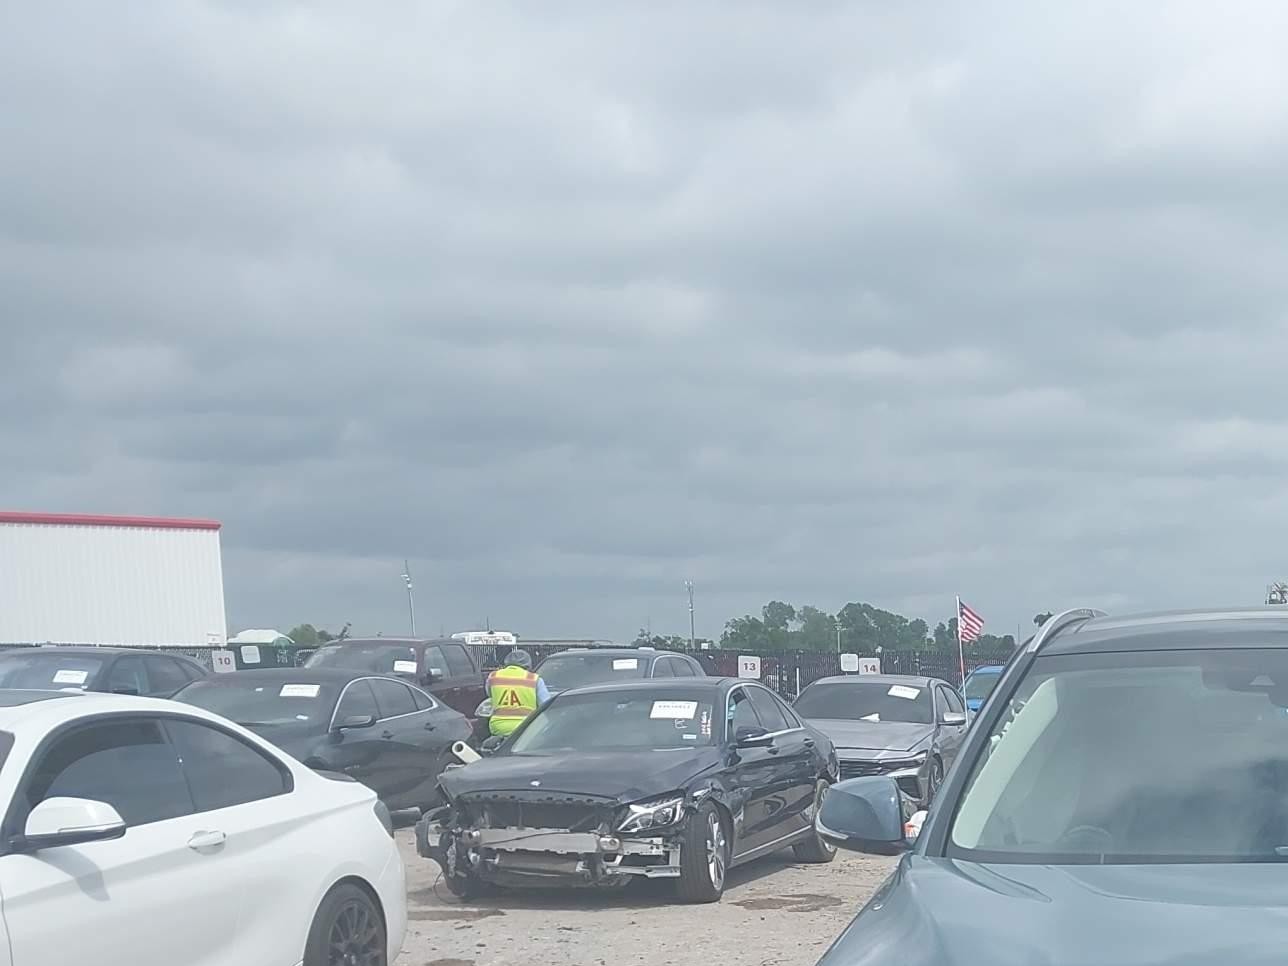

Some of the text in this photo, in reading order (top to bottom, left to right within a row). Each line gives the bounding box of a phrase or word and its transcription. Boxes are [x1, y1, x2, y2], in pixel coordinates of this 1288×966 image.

[217, 657, 231, 665] 10
[743, 662, 756, 671] 13
[863, 664, 877, 672] 14
